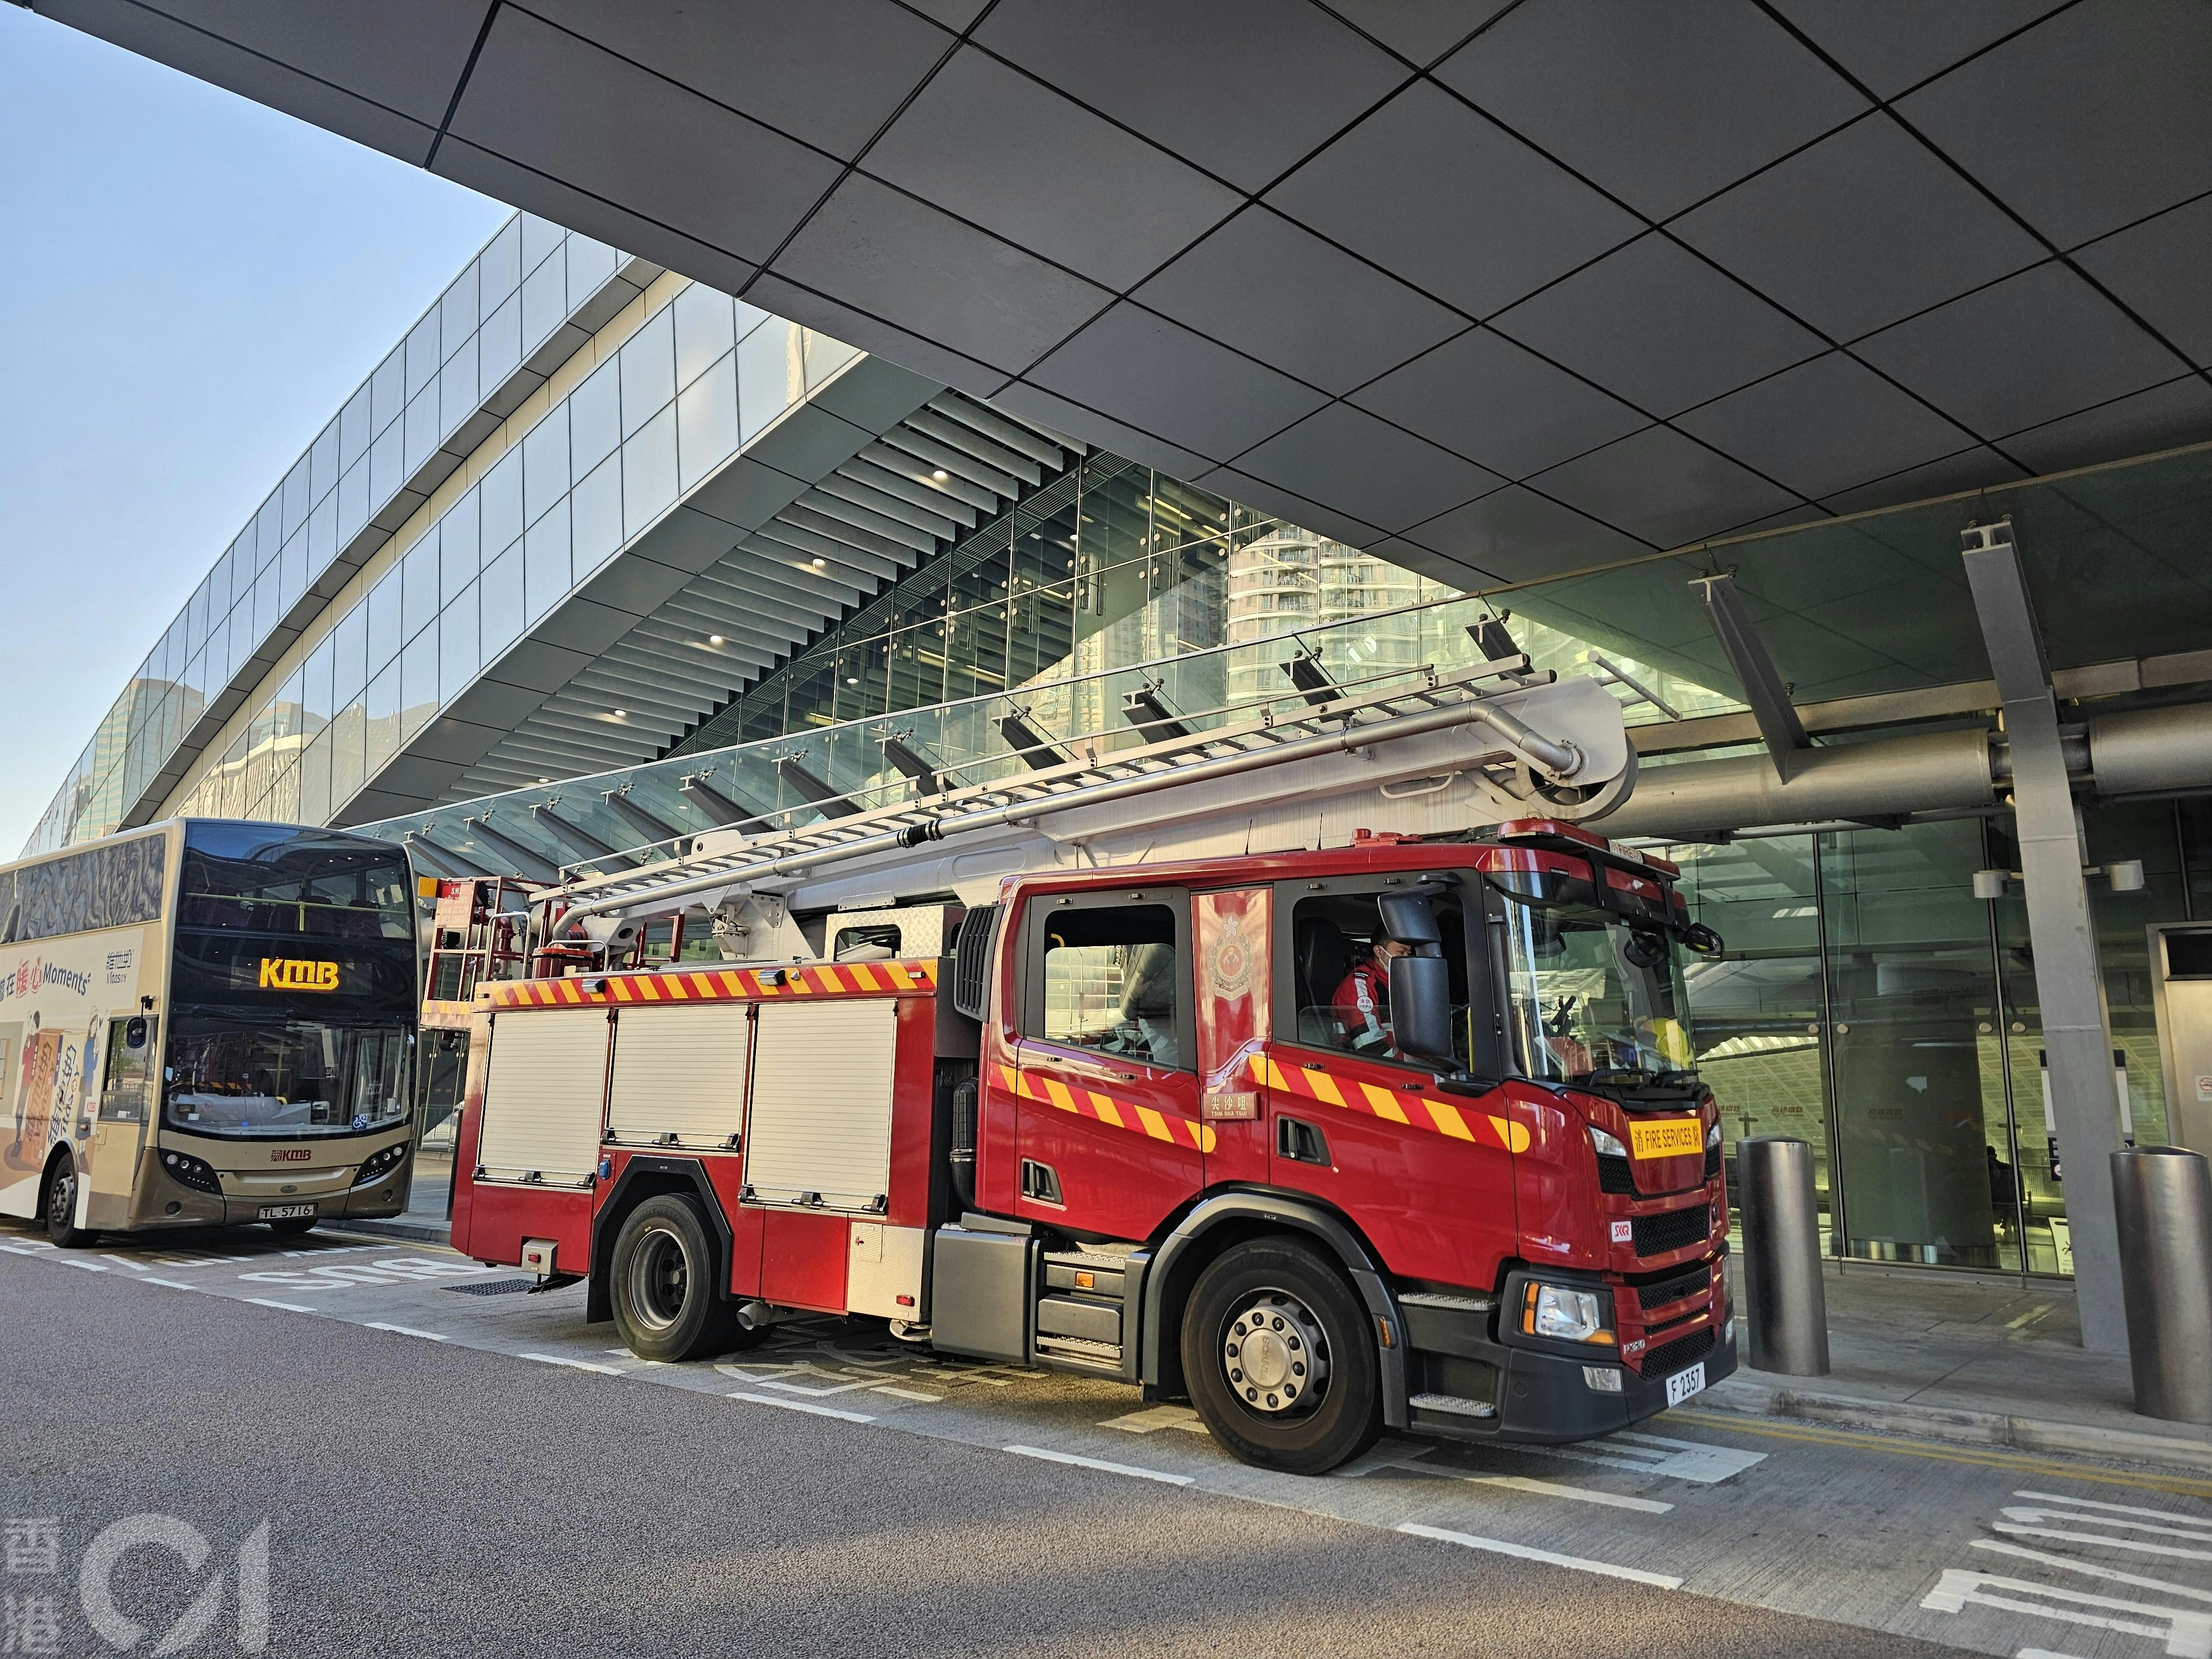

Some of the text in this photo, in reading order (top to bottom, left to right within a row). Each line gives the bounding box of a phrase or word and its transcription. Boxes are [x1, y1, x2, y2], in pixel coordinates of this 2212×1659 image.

[1618, 844, 1634, 859] FIRE
[259, 958, 339, 990] KMB
[1211, 1095, 1246, 1110] 尖沙咀
[1635, 1124, 1700, 1152] 消 FIRE SERVICES 防
[282, 1149, 311, 1161] KMB
[263, 1206, 310, 1218] TL 5716
[1671, 1368, 1700, 1401] F 2357
